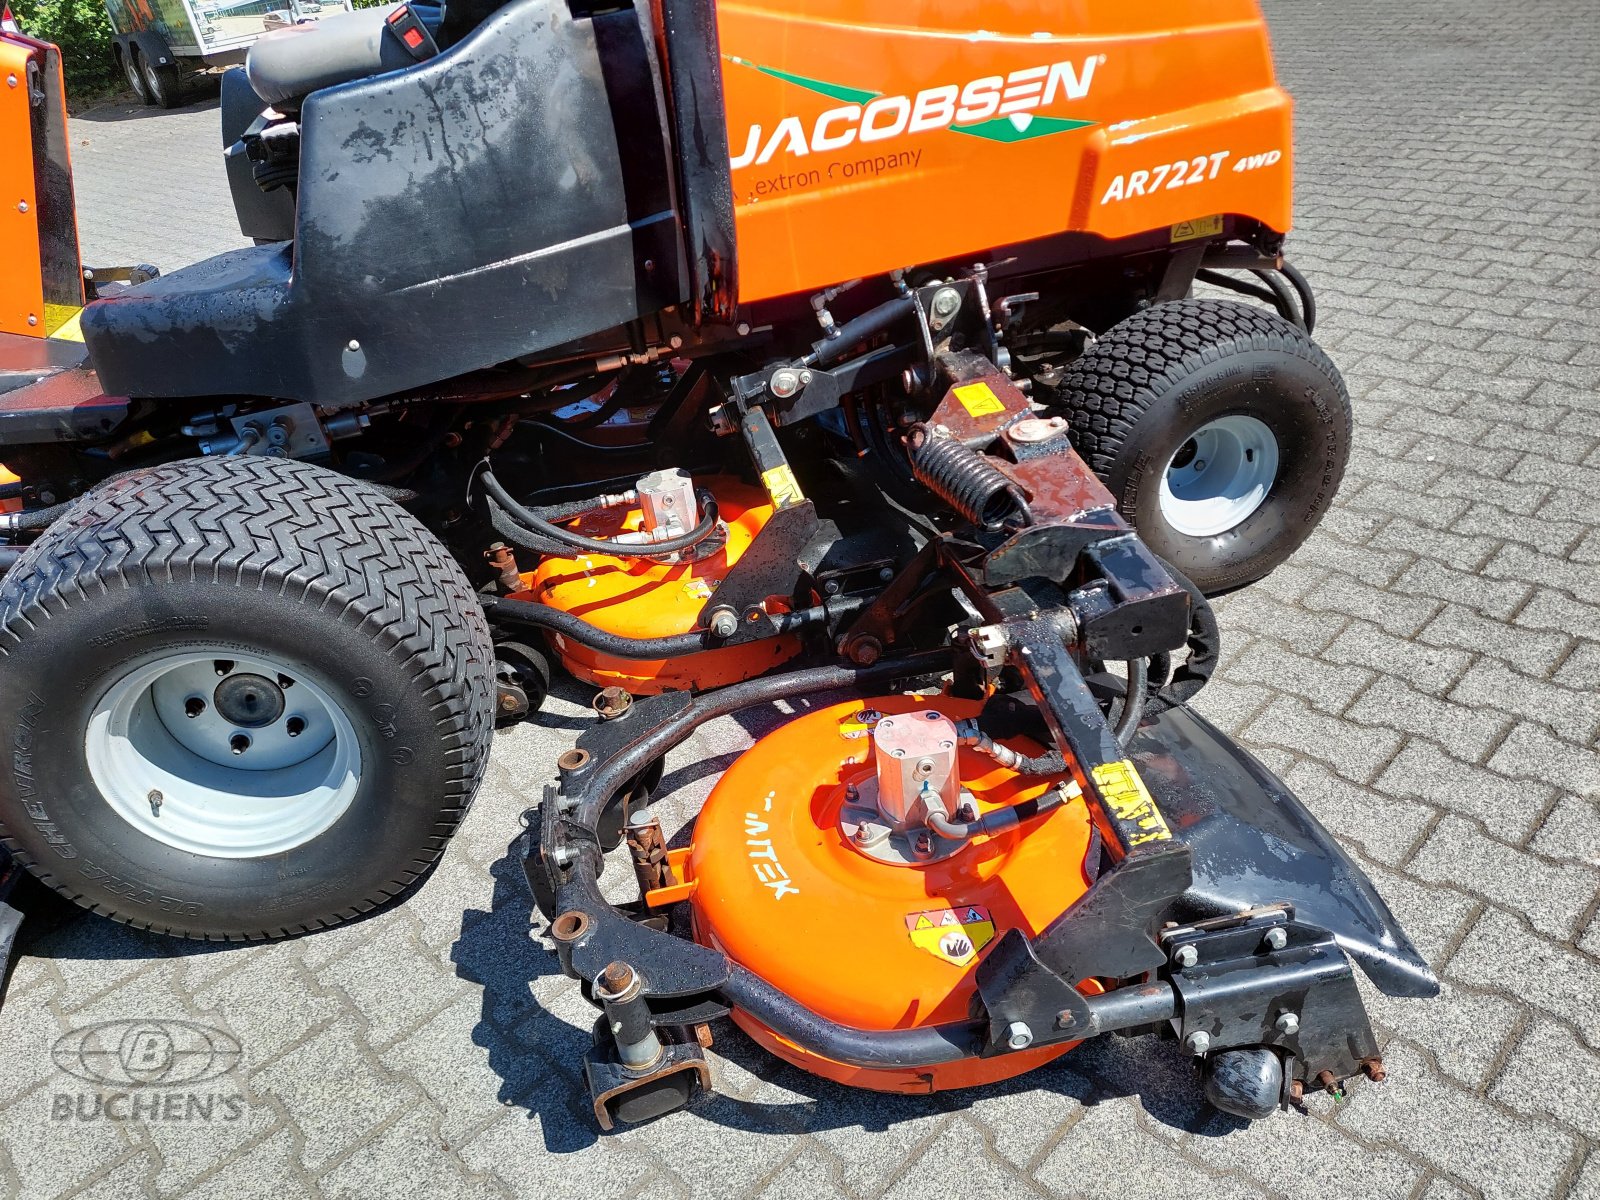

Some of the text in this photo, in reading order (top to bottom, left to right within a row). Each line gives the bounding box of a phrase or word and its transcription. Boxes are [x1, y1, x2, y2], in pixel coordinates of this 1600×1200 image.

[729, 55, 1097, 170] JACOBSEN
[749, 148, 922, 198] extron Company
[1100, 149, 1282, 205] AR722T 4WD
[12, 688, 79, 860] CHEVRON
